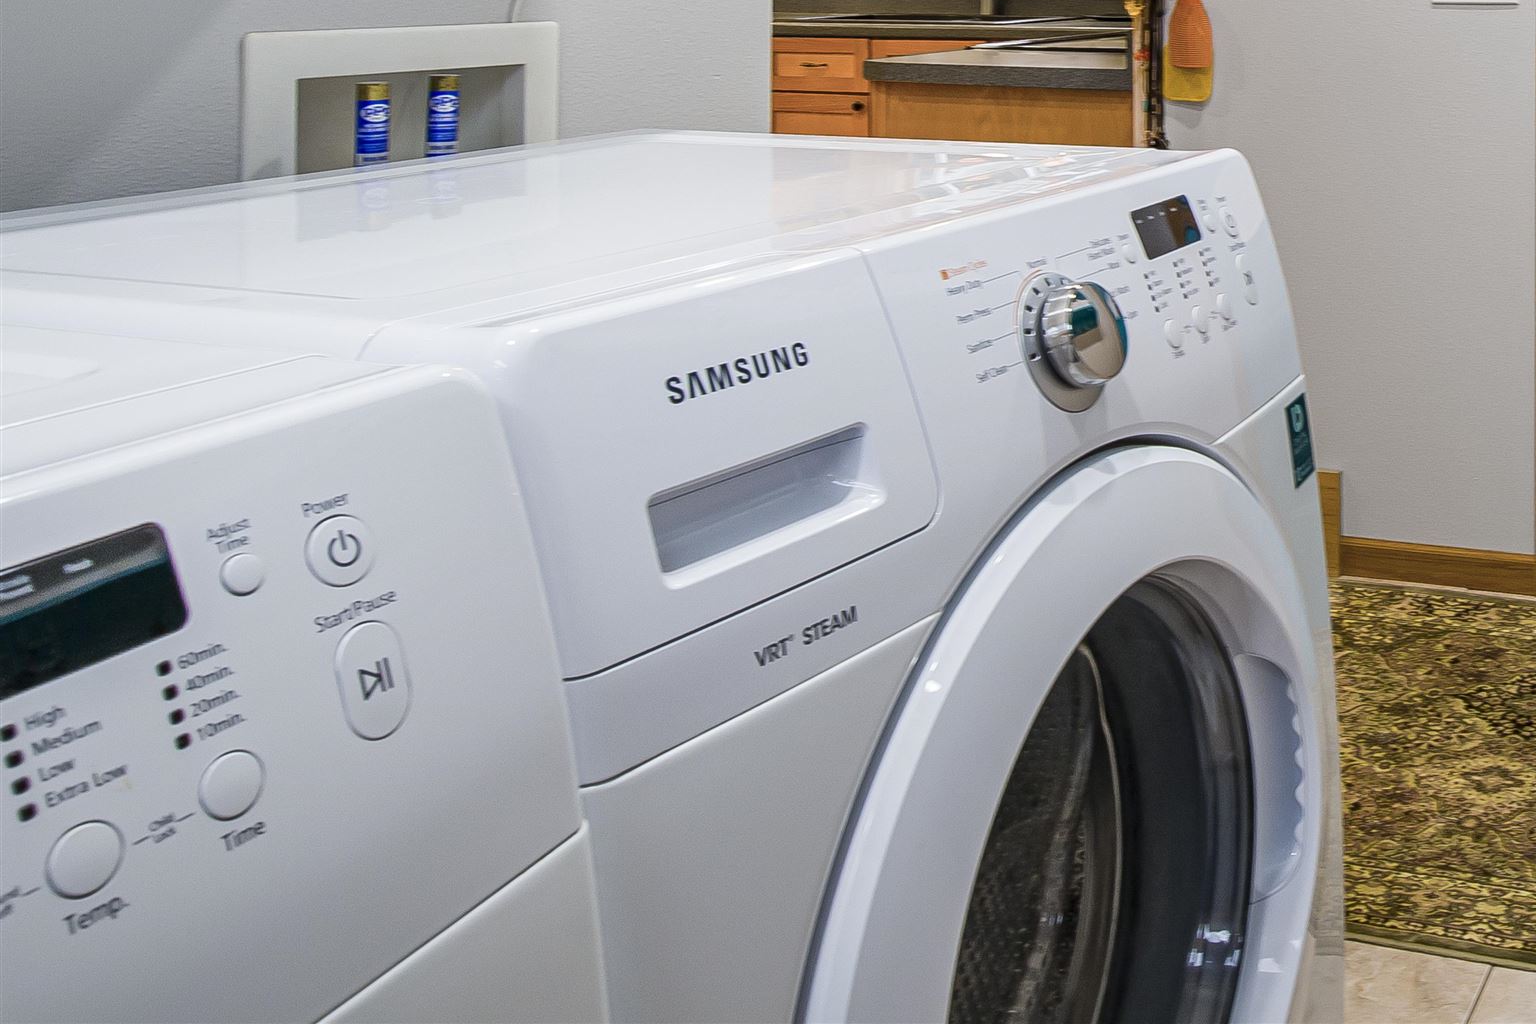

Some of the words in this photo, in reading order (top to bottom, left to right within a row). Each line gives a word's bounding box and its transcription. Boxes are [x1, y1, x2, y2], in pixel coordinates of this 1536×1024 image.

[665, 342, 808, 404] SAMSUNG
[301, 493, 349, 518] Power
[206, 519, 251, 542] Adjust
[214, 536, 250, 554] Time
[313, 591, 398, 634] Start/Pause
[802, 605, 858, 645] STEAM
[177, 643, 229, 670] 60min.
[185, 666, 235, 692] 40min.
[190, 689, 242, 718] 20min.
[23, 706, 66, 731] High
[31, 721, 103, 756] Medium
[38, 759, 76, 782] Low
[45, 781, 90, 808] Extra
[92, 765, 128, 787] Low
[220, 820, 268, 852] Time
[62, 896, 130, 935] Temp.
